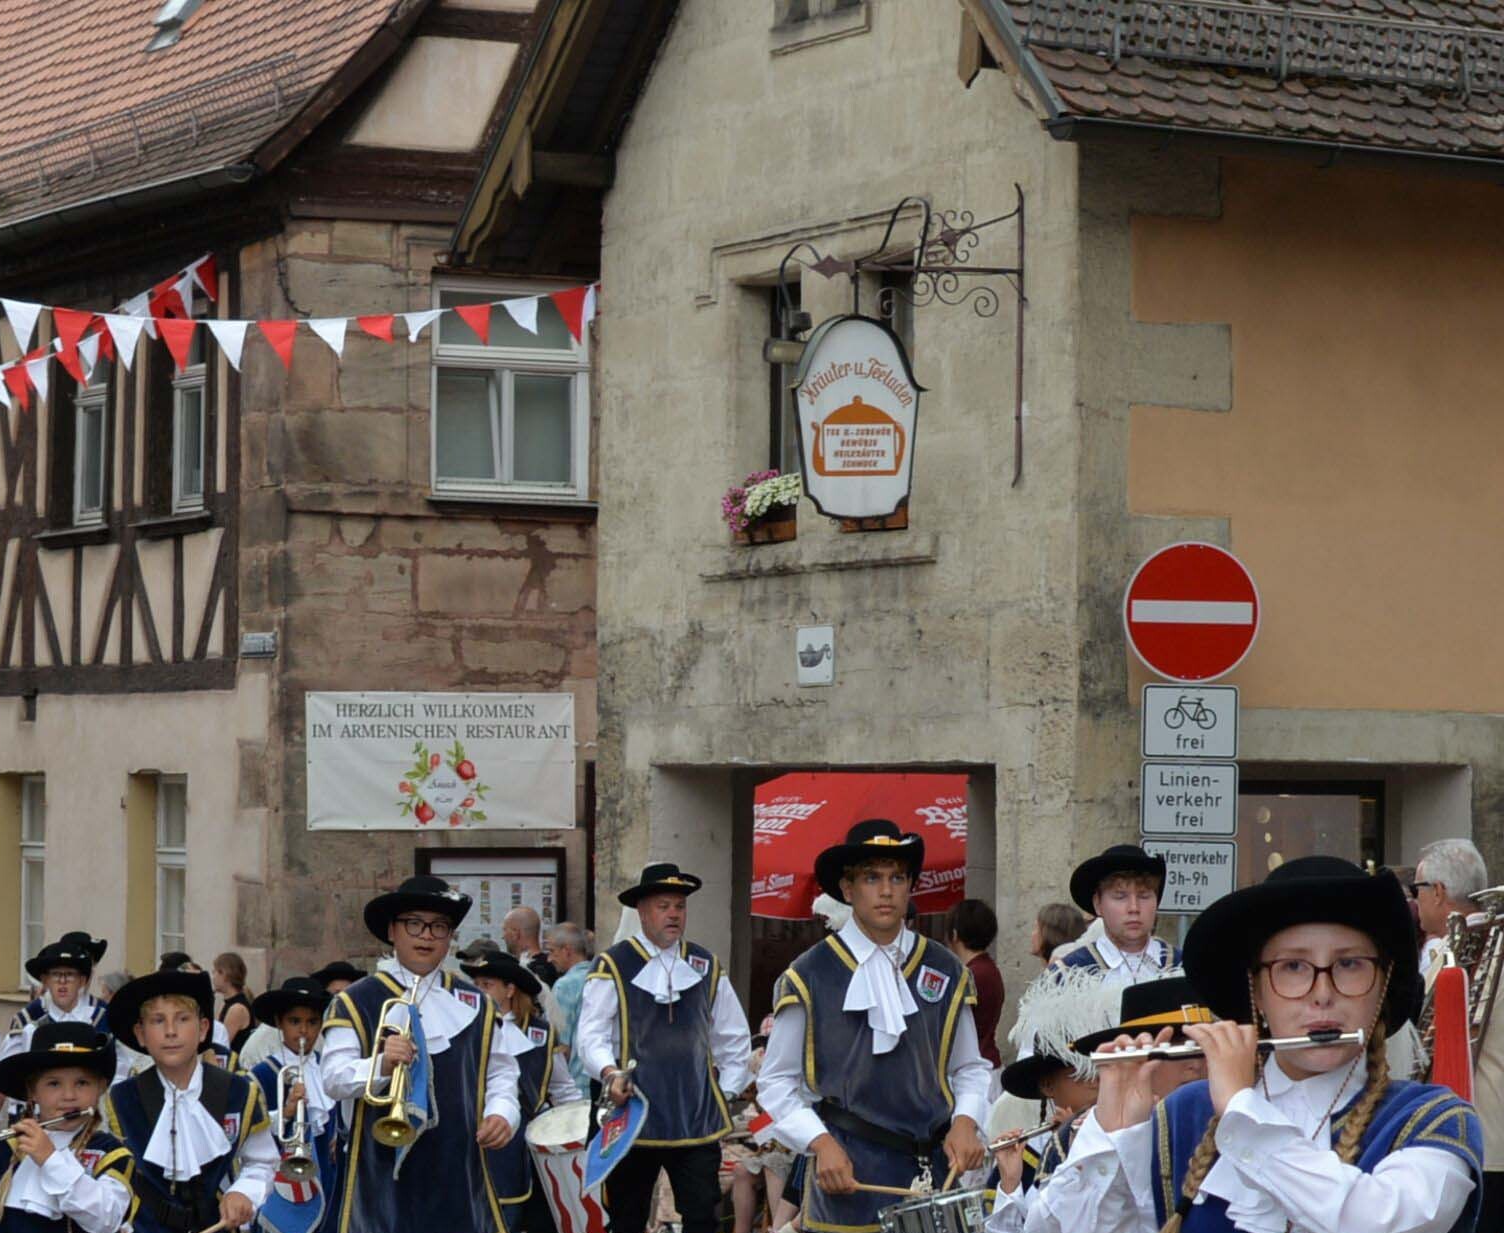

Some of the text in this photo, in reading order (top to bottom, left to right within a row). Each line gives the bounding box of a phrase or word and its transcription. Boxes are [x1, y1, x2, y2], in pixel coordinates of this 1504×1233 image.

[336, 703, 536, 719] HERZLICH WILLKOMMEN
[311, 723, 571, 740] IM ARMENISCHEN RESTAURANT
[1176, 734, 1205, 750] frei
[1159, 771, 1220, 788] Linien-
[1155, 792, 1223, 808] verkehr
[1174, 811, 1204, 827] frei
[1148, 848, 1229, 865] ferverkehr
[1173, 891, 1201, 906] frei
